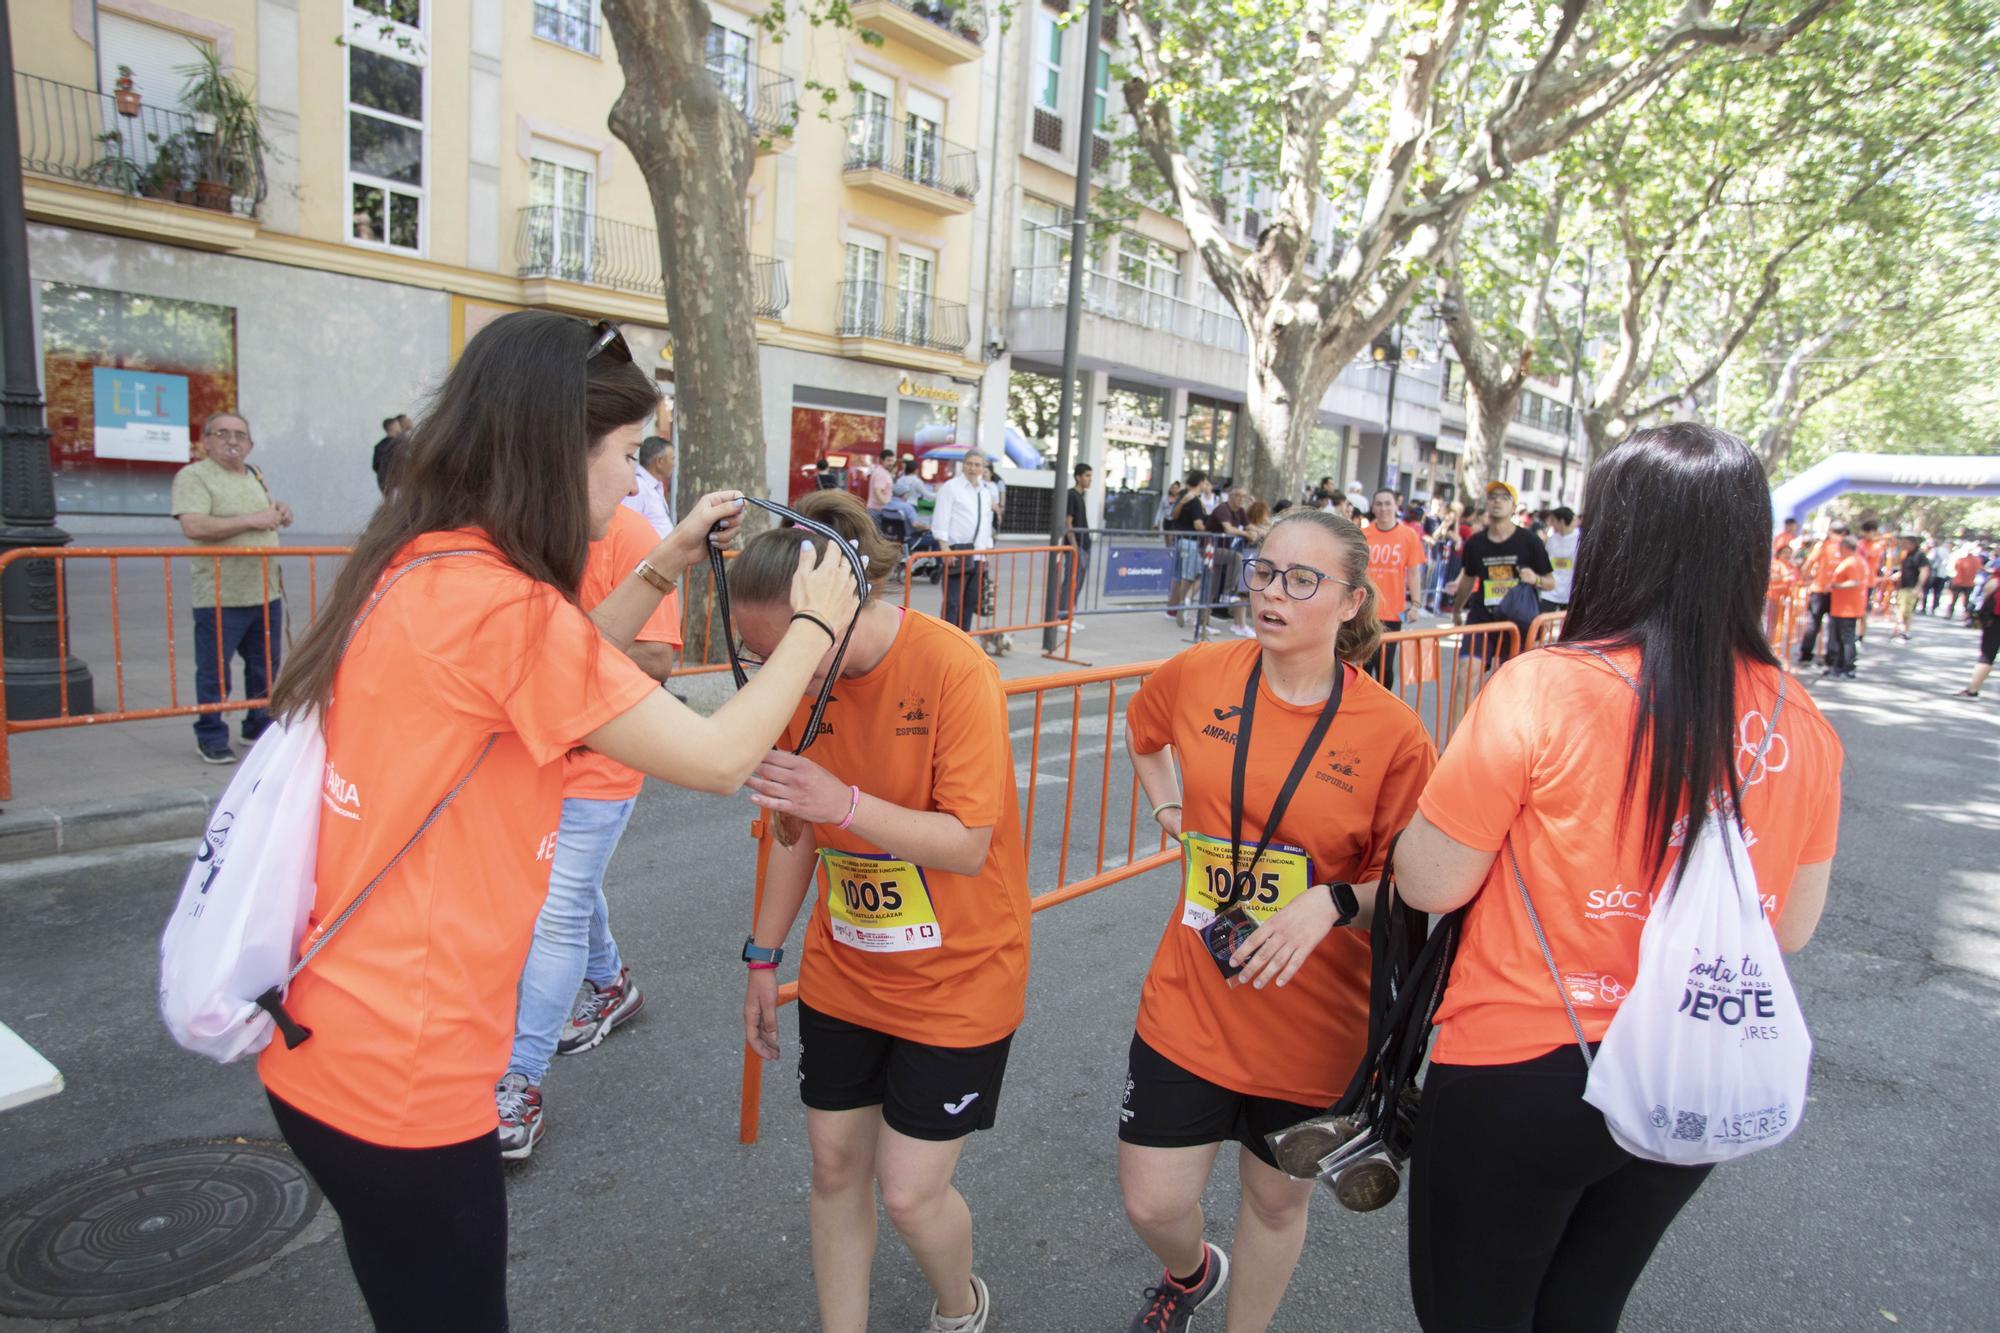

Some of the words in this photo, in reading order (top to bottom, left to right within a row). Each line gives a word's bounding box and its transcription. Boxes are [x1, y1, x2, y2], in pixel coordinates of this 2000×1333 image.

[1201, 724, 1239, 746] AMPAR
[1314, 770, 1354, 794] ESPURNA
[840, 878, 903, 912] 1005
[1205, 864, 1281, 904] 1005
[1586, 884, 1642, 910] SÓC
[1741, 953, 1762, 977] tu
[1743, 1025, 1779, 1041] IRES
